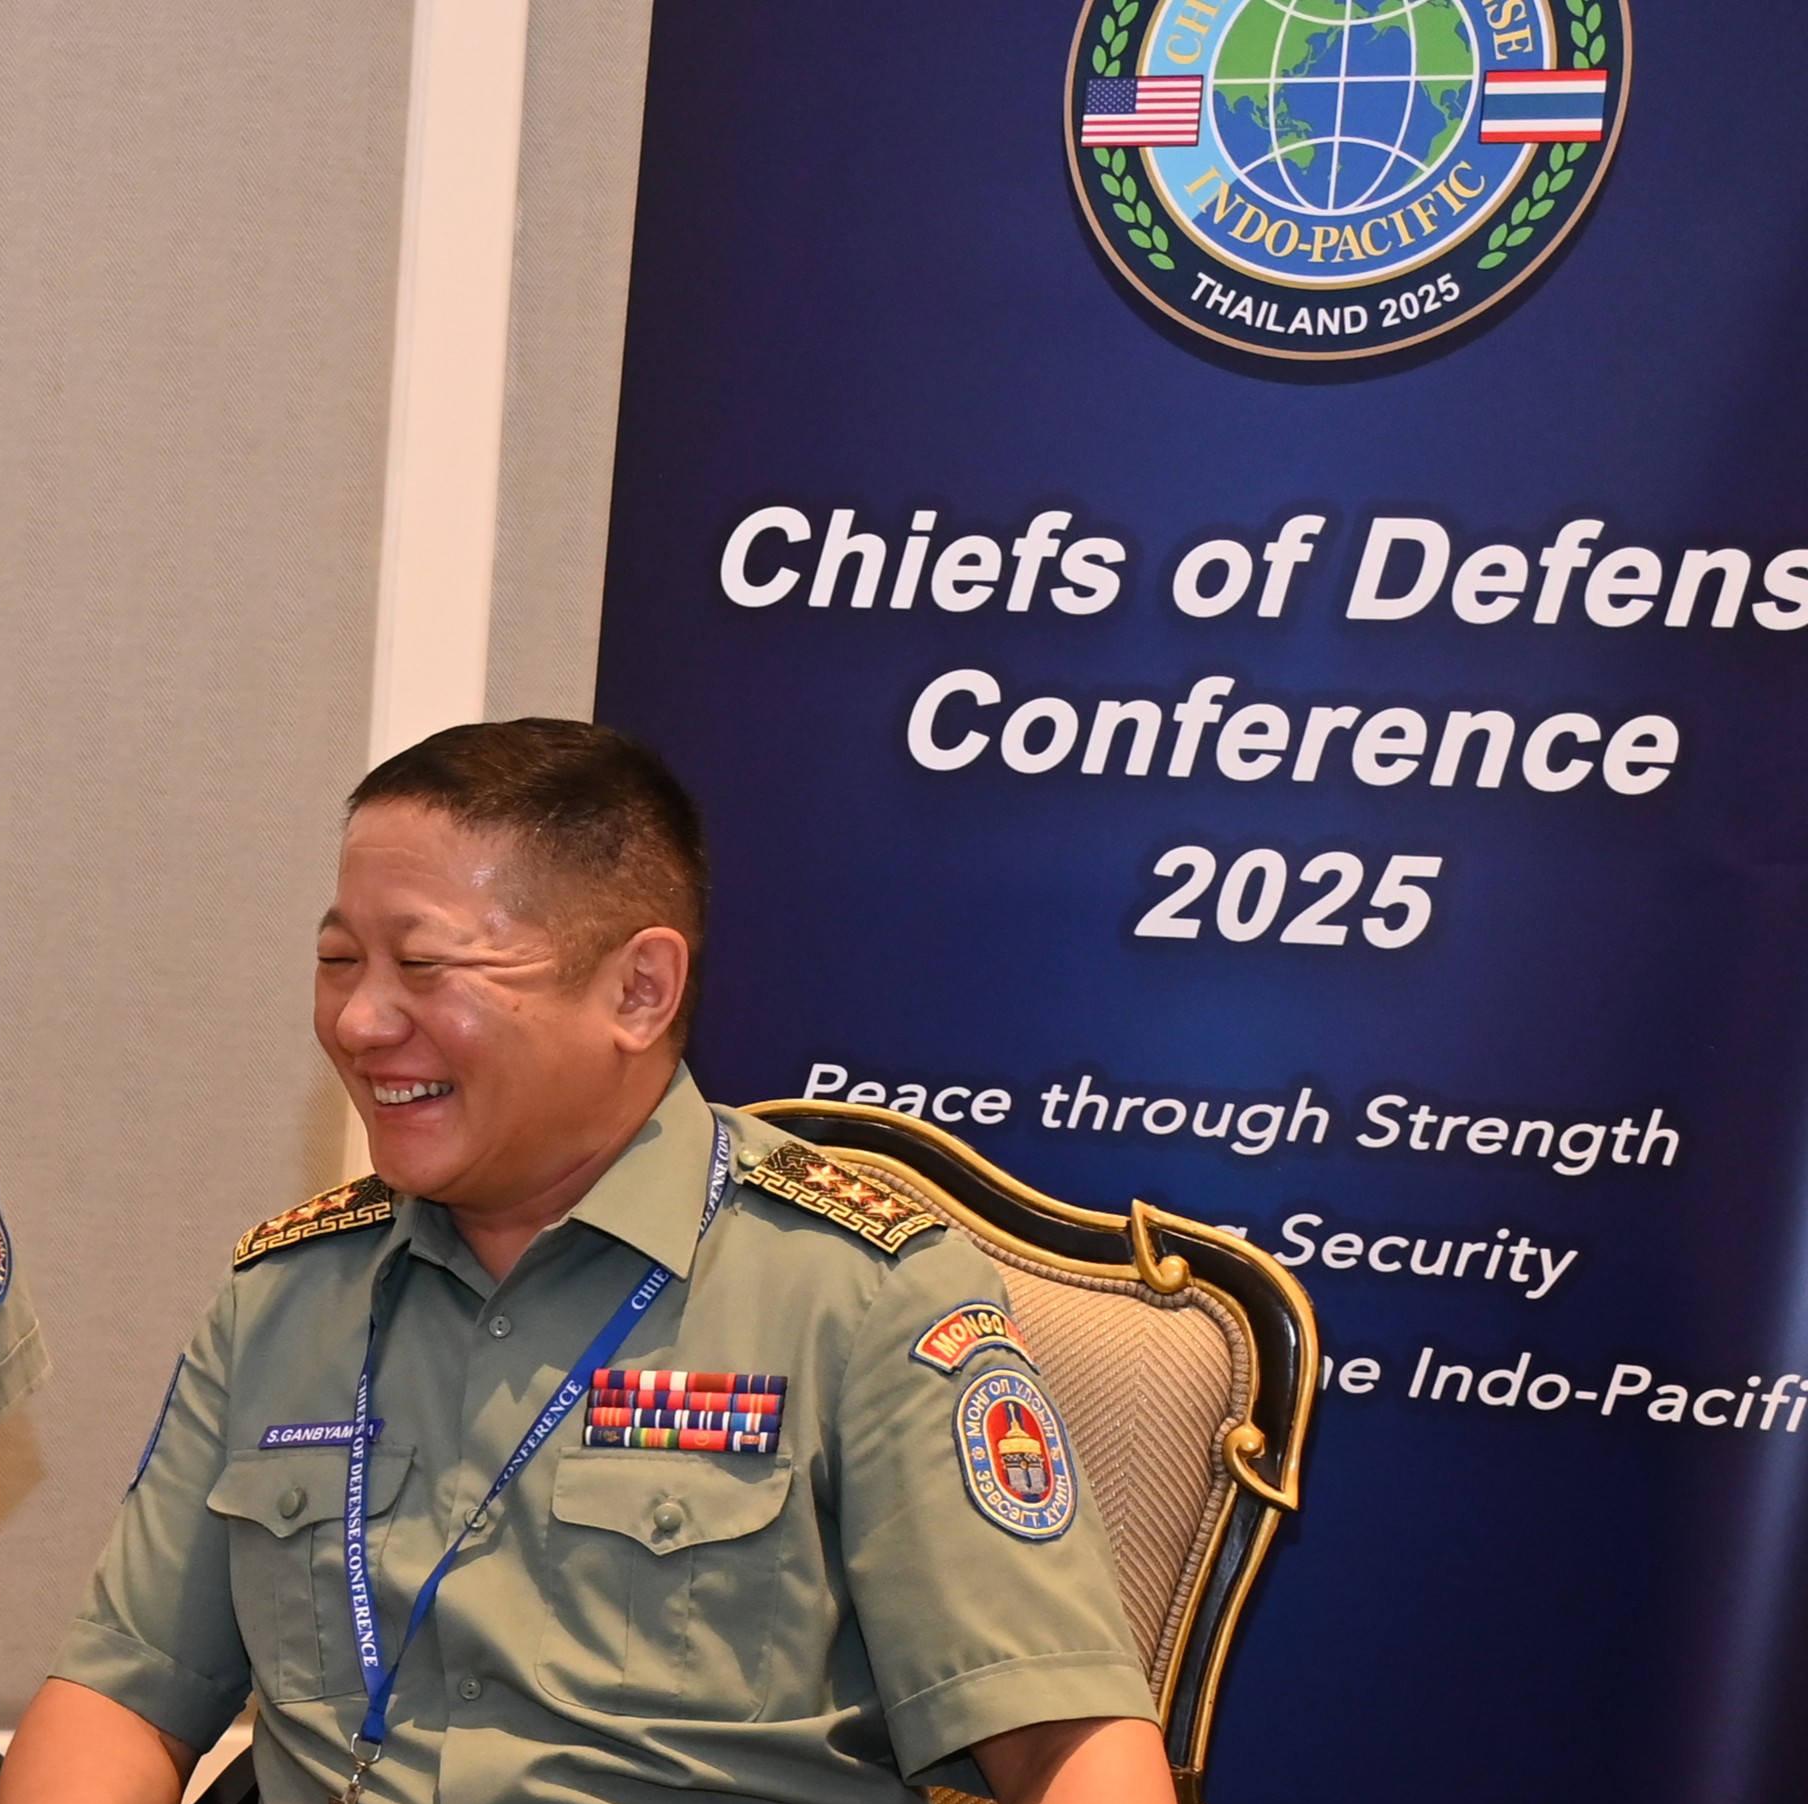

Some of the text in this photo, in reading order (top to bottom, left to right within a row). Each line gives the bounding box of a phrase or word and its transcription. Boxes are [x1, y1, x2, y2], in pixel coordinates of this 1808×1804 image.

[1184, 160, 1485, 263] INDO-PACIFIC
[1190, 272, 1460, 335] THAILAND 2025
[720, 506, 1808, 631] Chiefs of Defens
[907, 668, 1680, 795] Conference
[1134, 845, 1443, 949] 2025
[803, 1063, 1680, 1176] Peace through Strength
[631, 1268, 669, 1310] CHIE
[1274, 1213, 1578, 1300] Security
[496, 1380, 582, 1491] CONFERENCE
[967, 1378, 1010, 1437] МОНГОЛ
[1408, 1347, 1808, 1433] Indo-Pacifi
[352, 1437, 364, 1459] OF
[348, 1462, 364, 1541] DEFENSE
[348, 1543, 378, 1667] CONFERENCE
